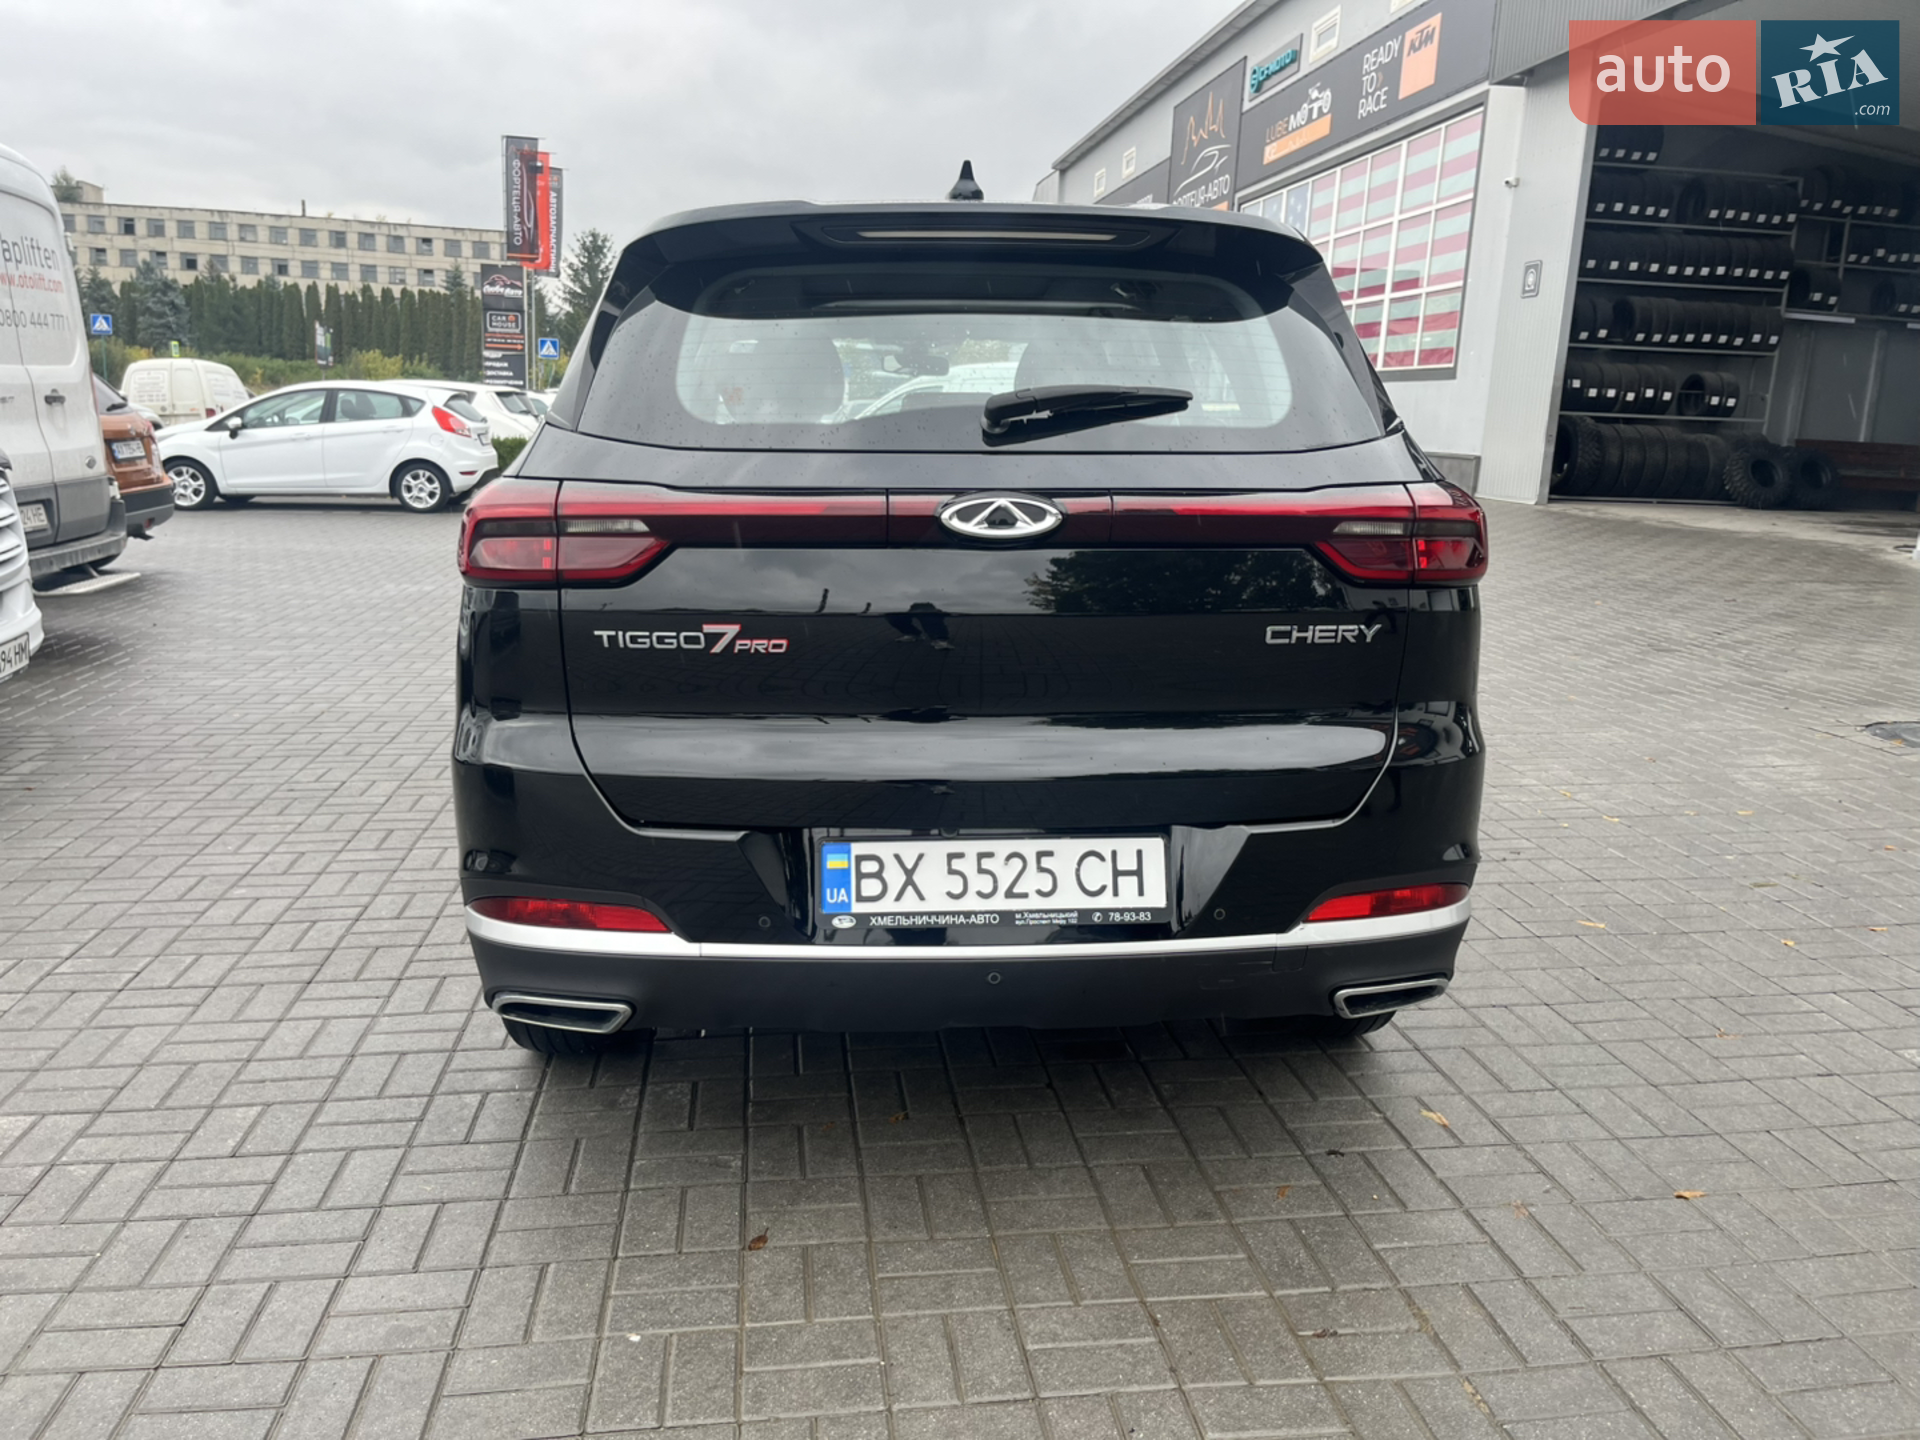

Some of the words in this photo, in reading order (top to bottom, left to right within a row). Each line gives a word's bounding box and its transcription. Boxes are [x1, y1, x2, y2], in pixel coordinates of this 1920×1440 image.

[1362, 34, 1402, 75] READY
[1407, 24, 1436, 57] KTM
[1362, 71, 1377, 96] TO
[1358, 86, 1388, 119] RACE
[512, 158, 524, 246] ФОРТЕЦЯ-АВТО
[1, 235, 60, 271] apliften
[30, 312, 49, 329] 444
[593, 629, 705, 650] TIGGO
[702, 623, 742, 654] 7
[733, 639, 790, 654] PRO
[1265, 623, 1382, 645] CHERY
[854, 853, 926, 903] BX
[944, 850, 1058, 900] 5525
[1074, 848, 1144, 898] CH
[826, 887, 849, 903] UA
[869, 913, 1000, 927] ХМЕЛЬНИЧЧИНА-АВТО
[1108, 911, 1152, 922] 78-93-83
